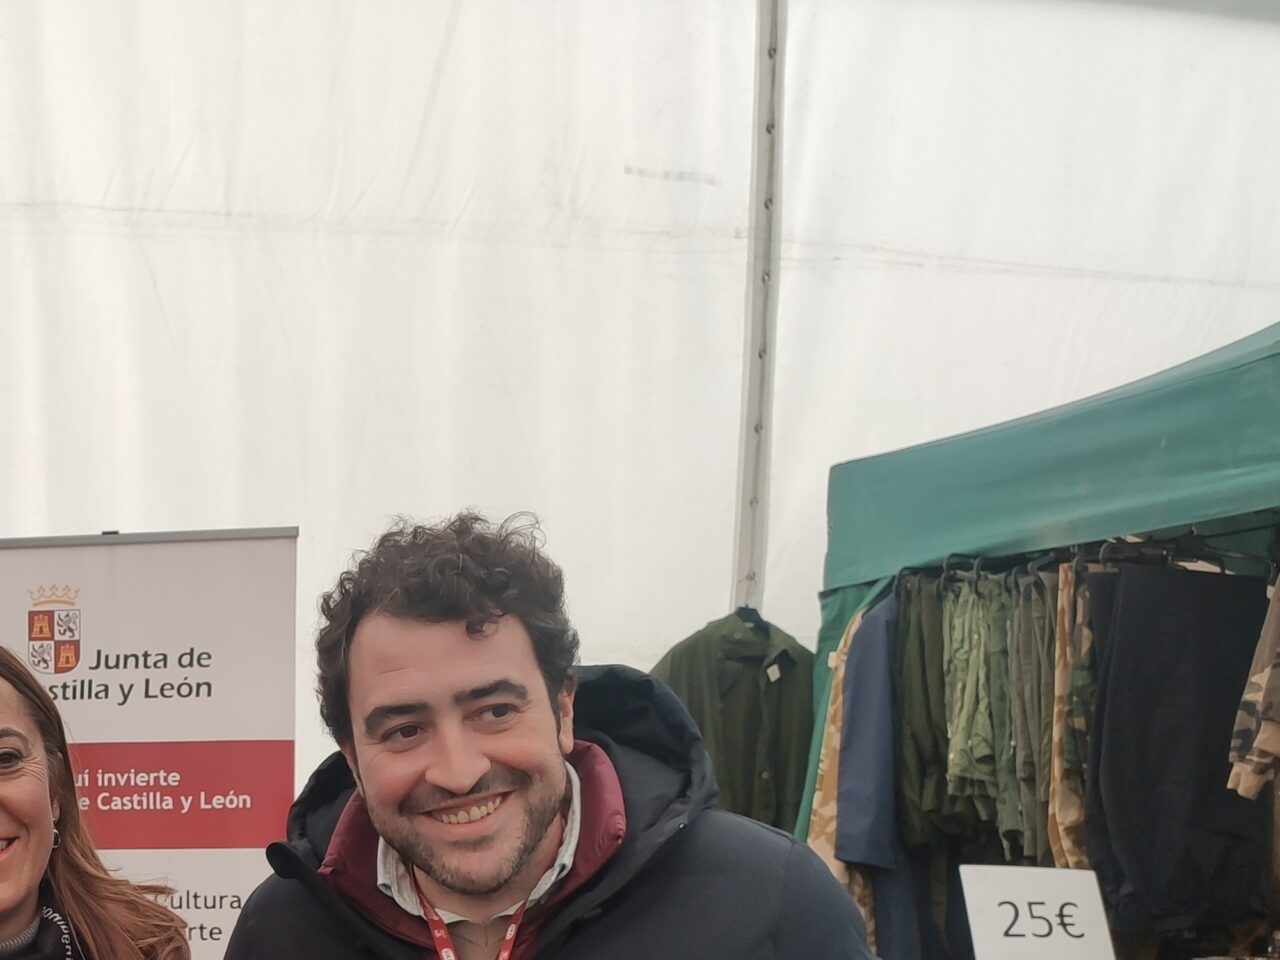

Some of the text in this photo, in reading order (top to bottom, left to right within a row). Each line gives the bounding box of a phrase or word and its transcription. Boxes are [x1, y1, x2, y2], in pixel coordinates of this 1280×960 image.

[88, 647, 213, 671] Junta de
[48, 676, 213, 706] stilla y León
[96, 768, 181, 788] invierte
[96, 791, 174, 811] Castilla
[180, 795, 193, 814] y
[199, 790, 252, 811] León
[997, 900, 1085, 939] 25€
